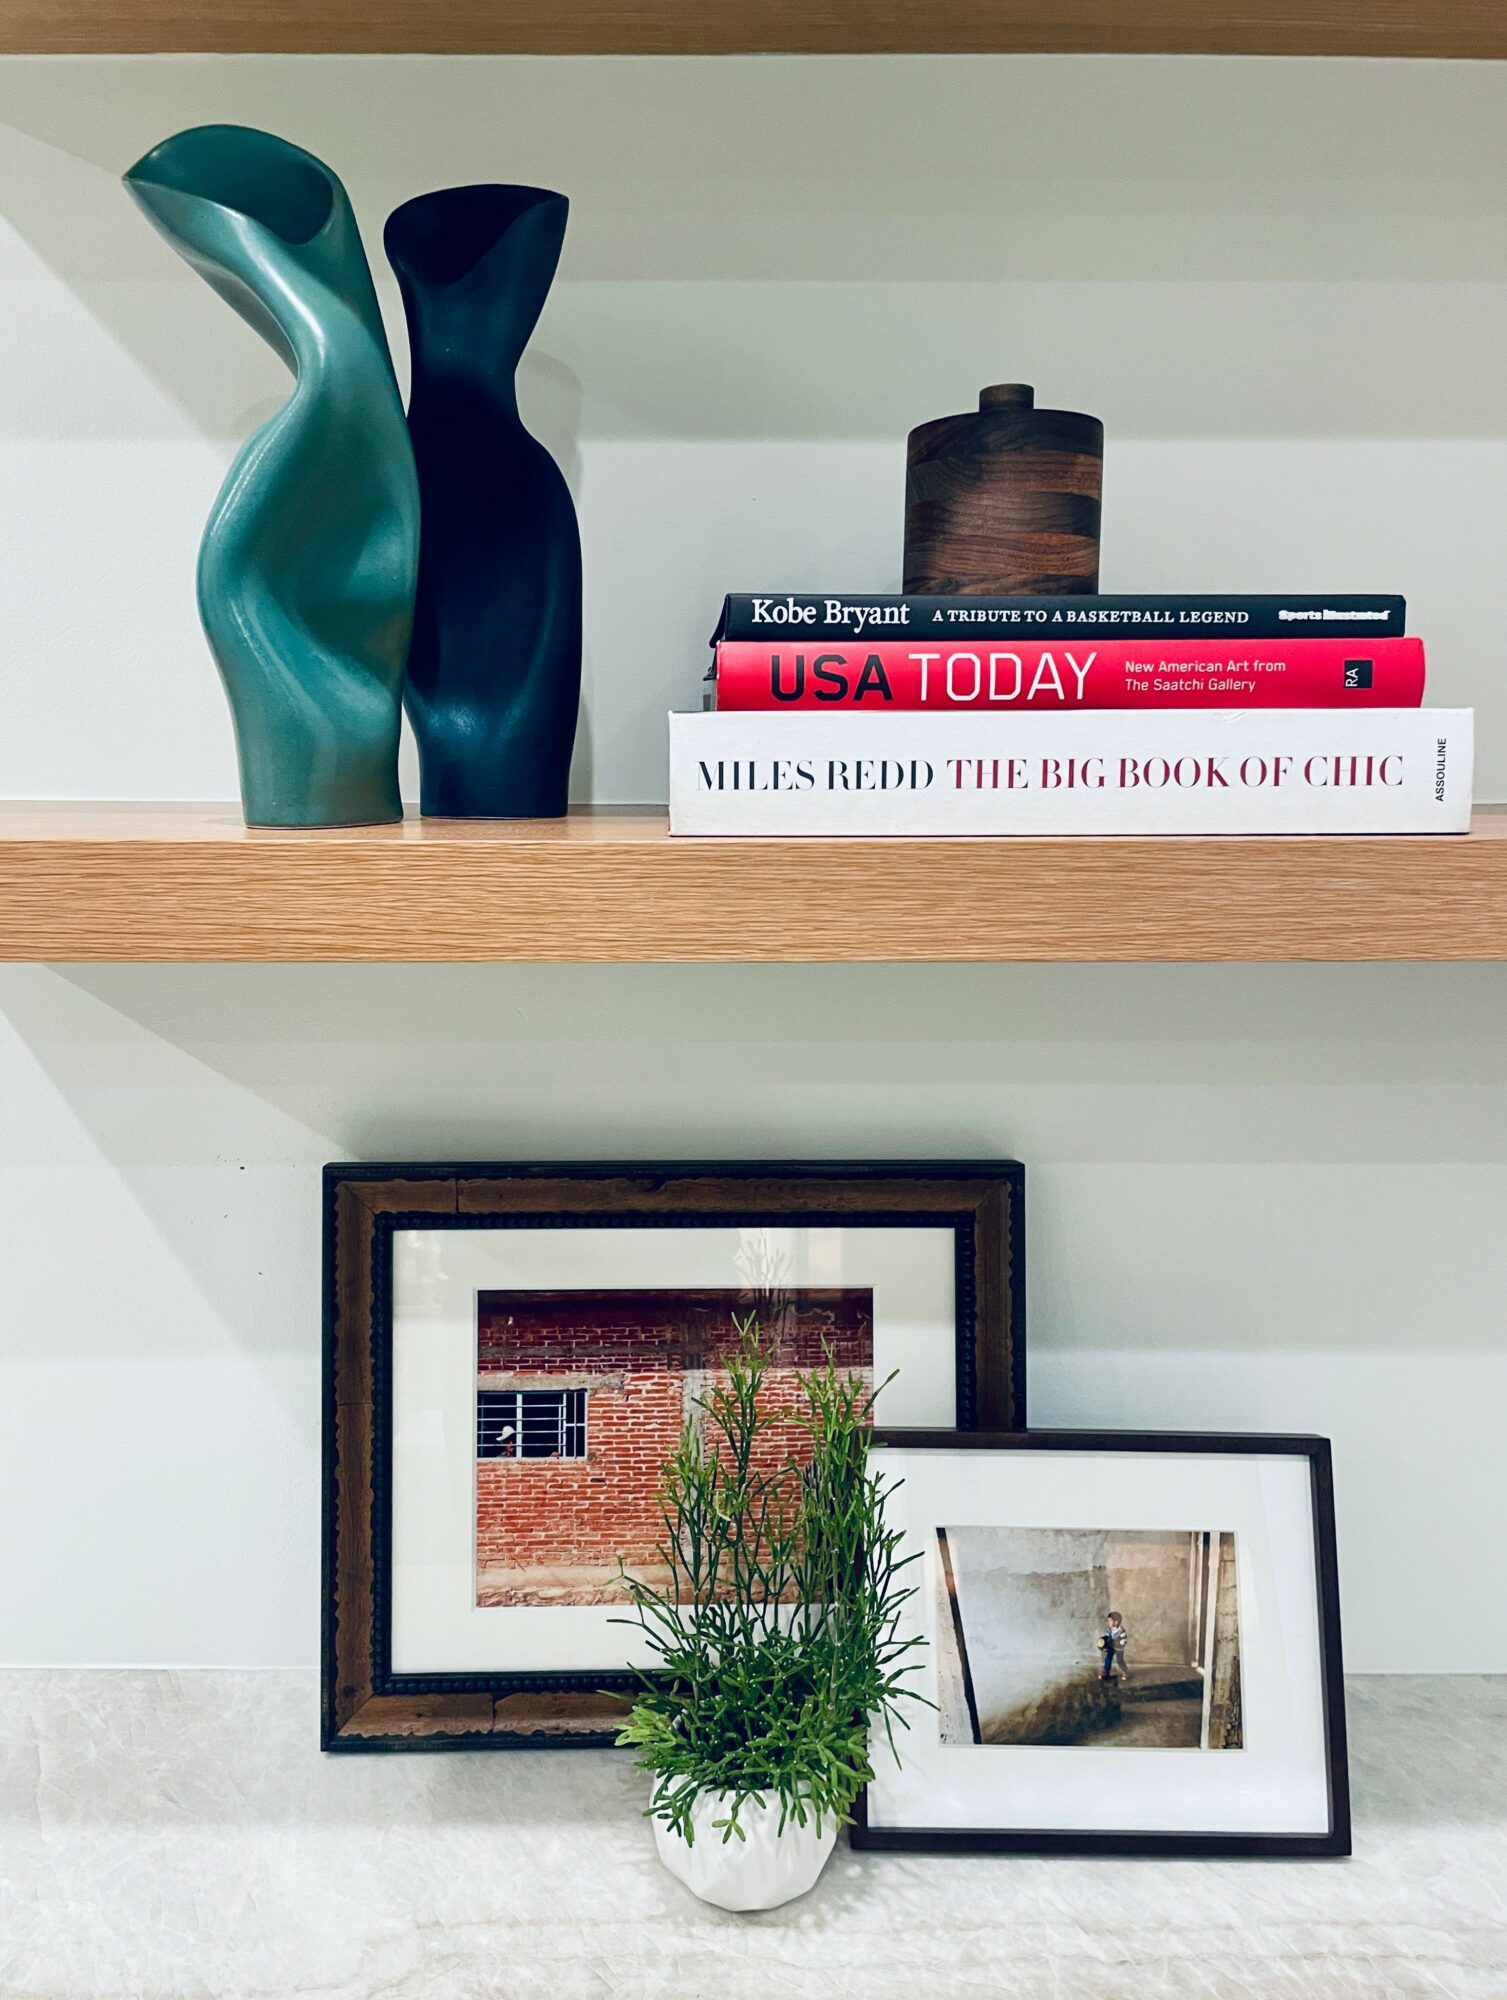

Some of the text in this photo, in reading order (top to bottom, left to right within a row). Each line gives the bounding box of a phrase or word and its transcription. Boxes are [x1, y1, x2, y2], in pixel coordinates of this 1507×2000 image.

[751, 598, 910, 633] Kobe Bryant
[932, 608, 1249, 623] A TRIBUTE TO A BASKETBALL LEGEND
[771, 652, 1097, 701] USA TODAY
[1125, 660, 1286, 673] New American Art from
[1345, 668, 1359, 688] RA
[1125, 678, 1256, 693] The Saatchi Gallery
[696, 755, 1403, 792] MILES REDD THE BIG BOOK OF CHIC
[1435, 738, 1447, 802] ASSOULINE
